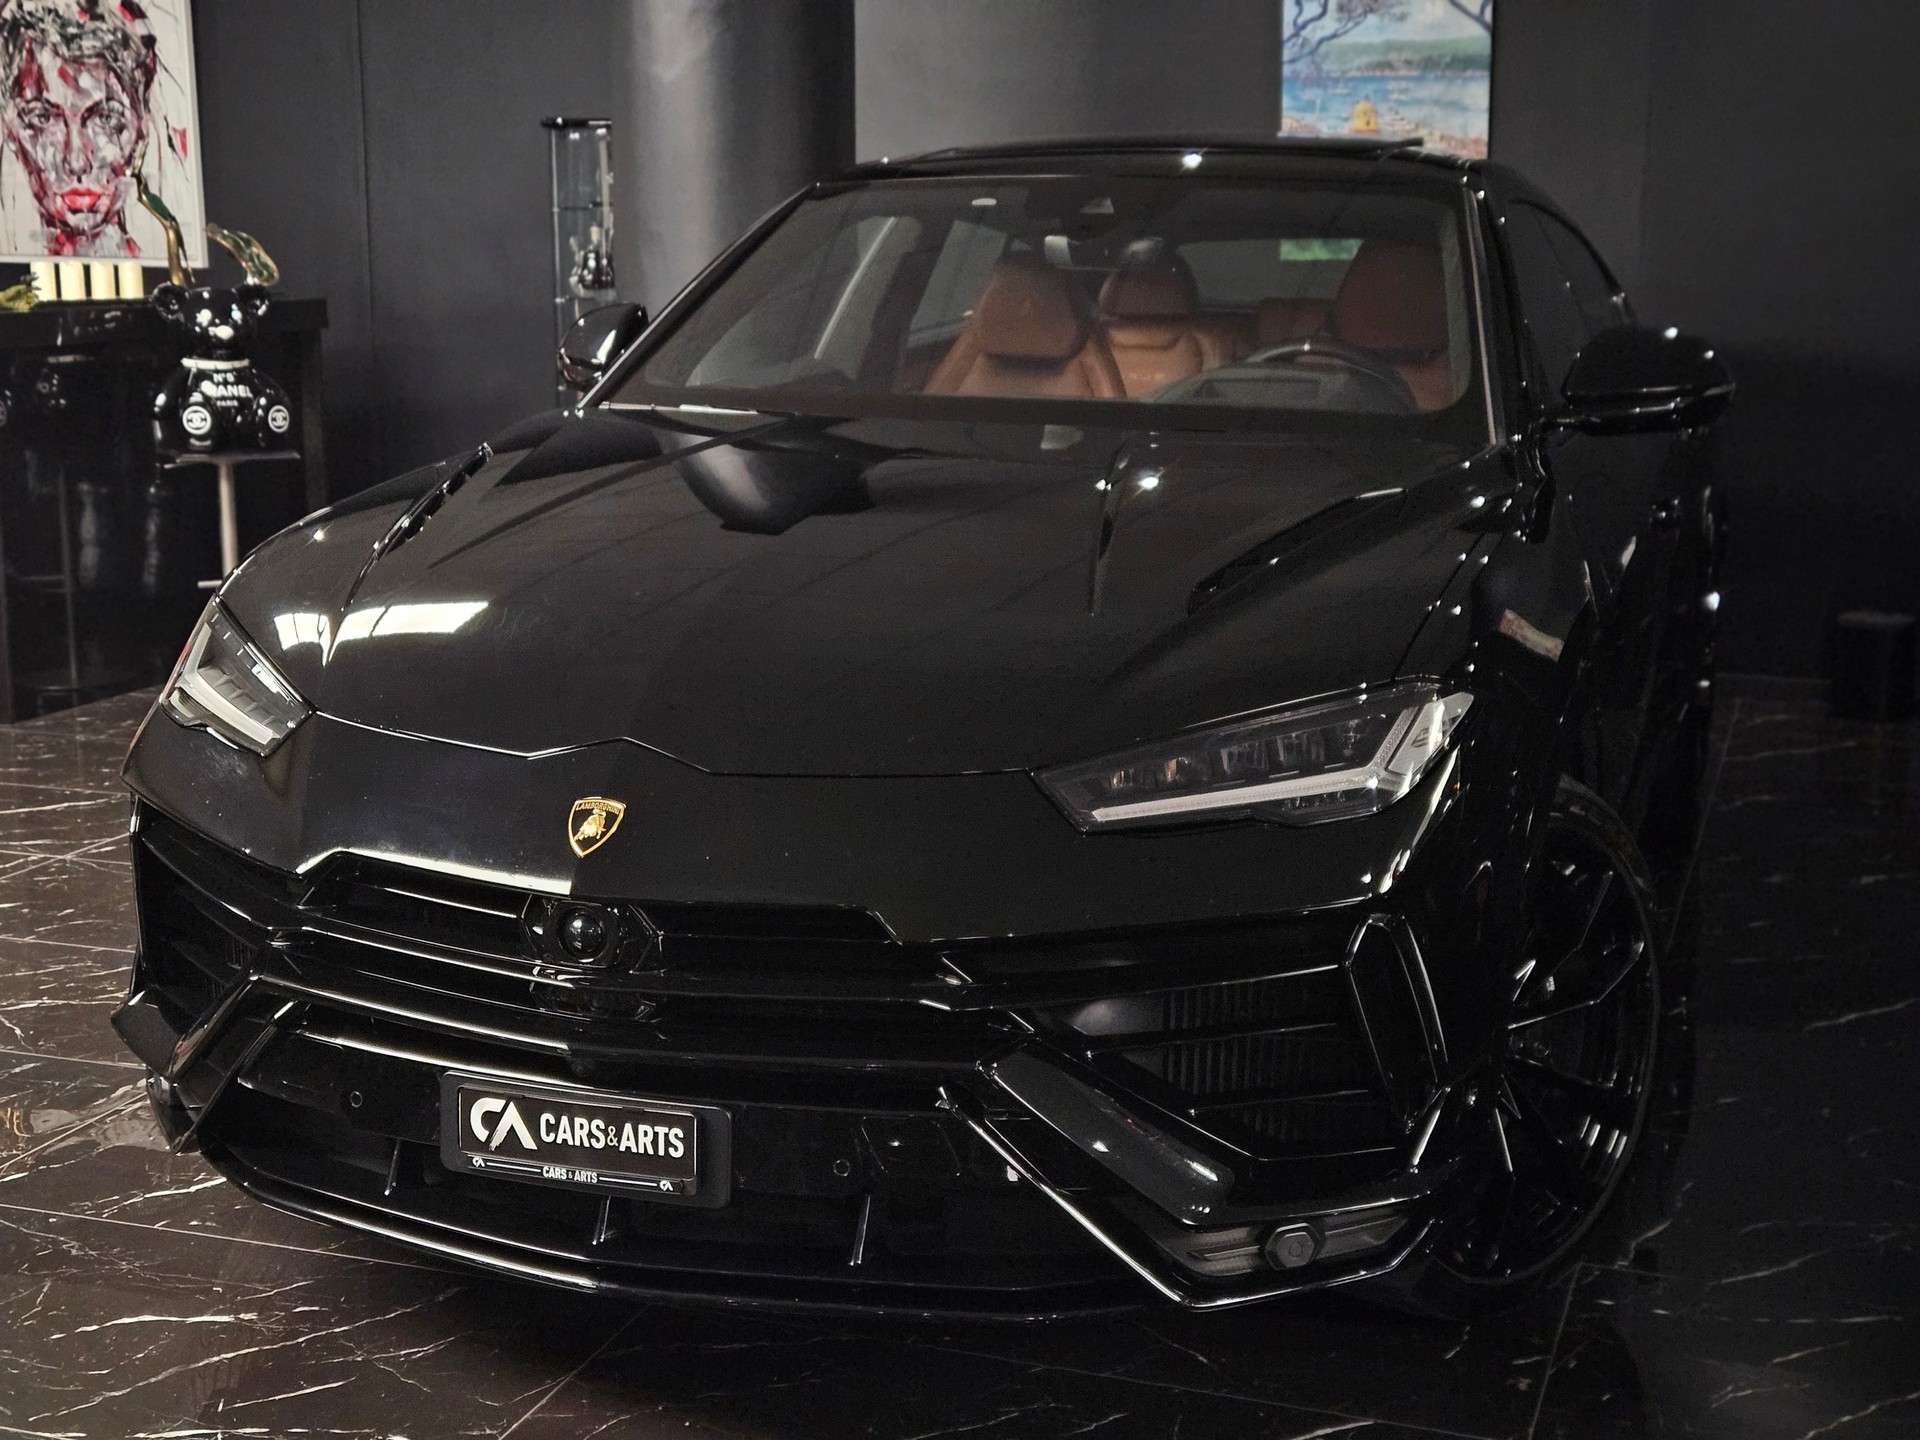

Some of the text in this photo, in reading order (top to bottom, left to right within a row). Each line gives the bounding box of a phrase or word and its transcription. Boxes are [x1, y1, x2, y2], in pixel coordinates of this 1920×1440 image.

[576, 802, 620, 815] LAMBORGHINI
[543, 1166, 567, 1180] CARS
[574, 1170, 598, 1183] ARTS
